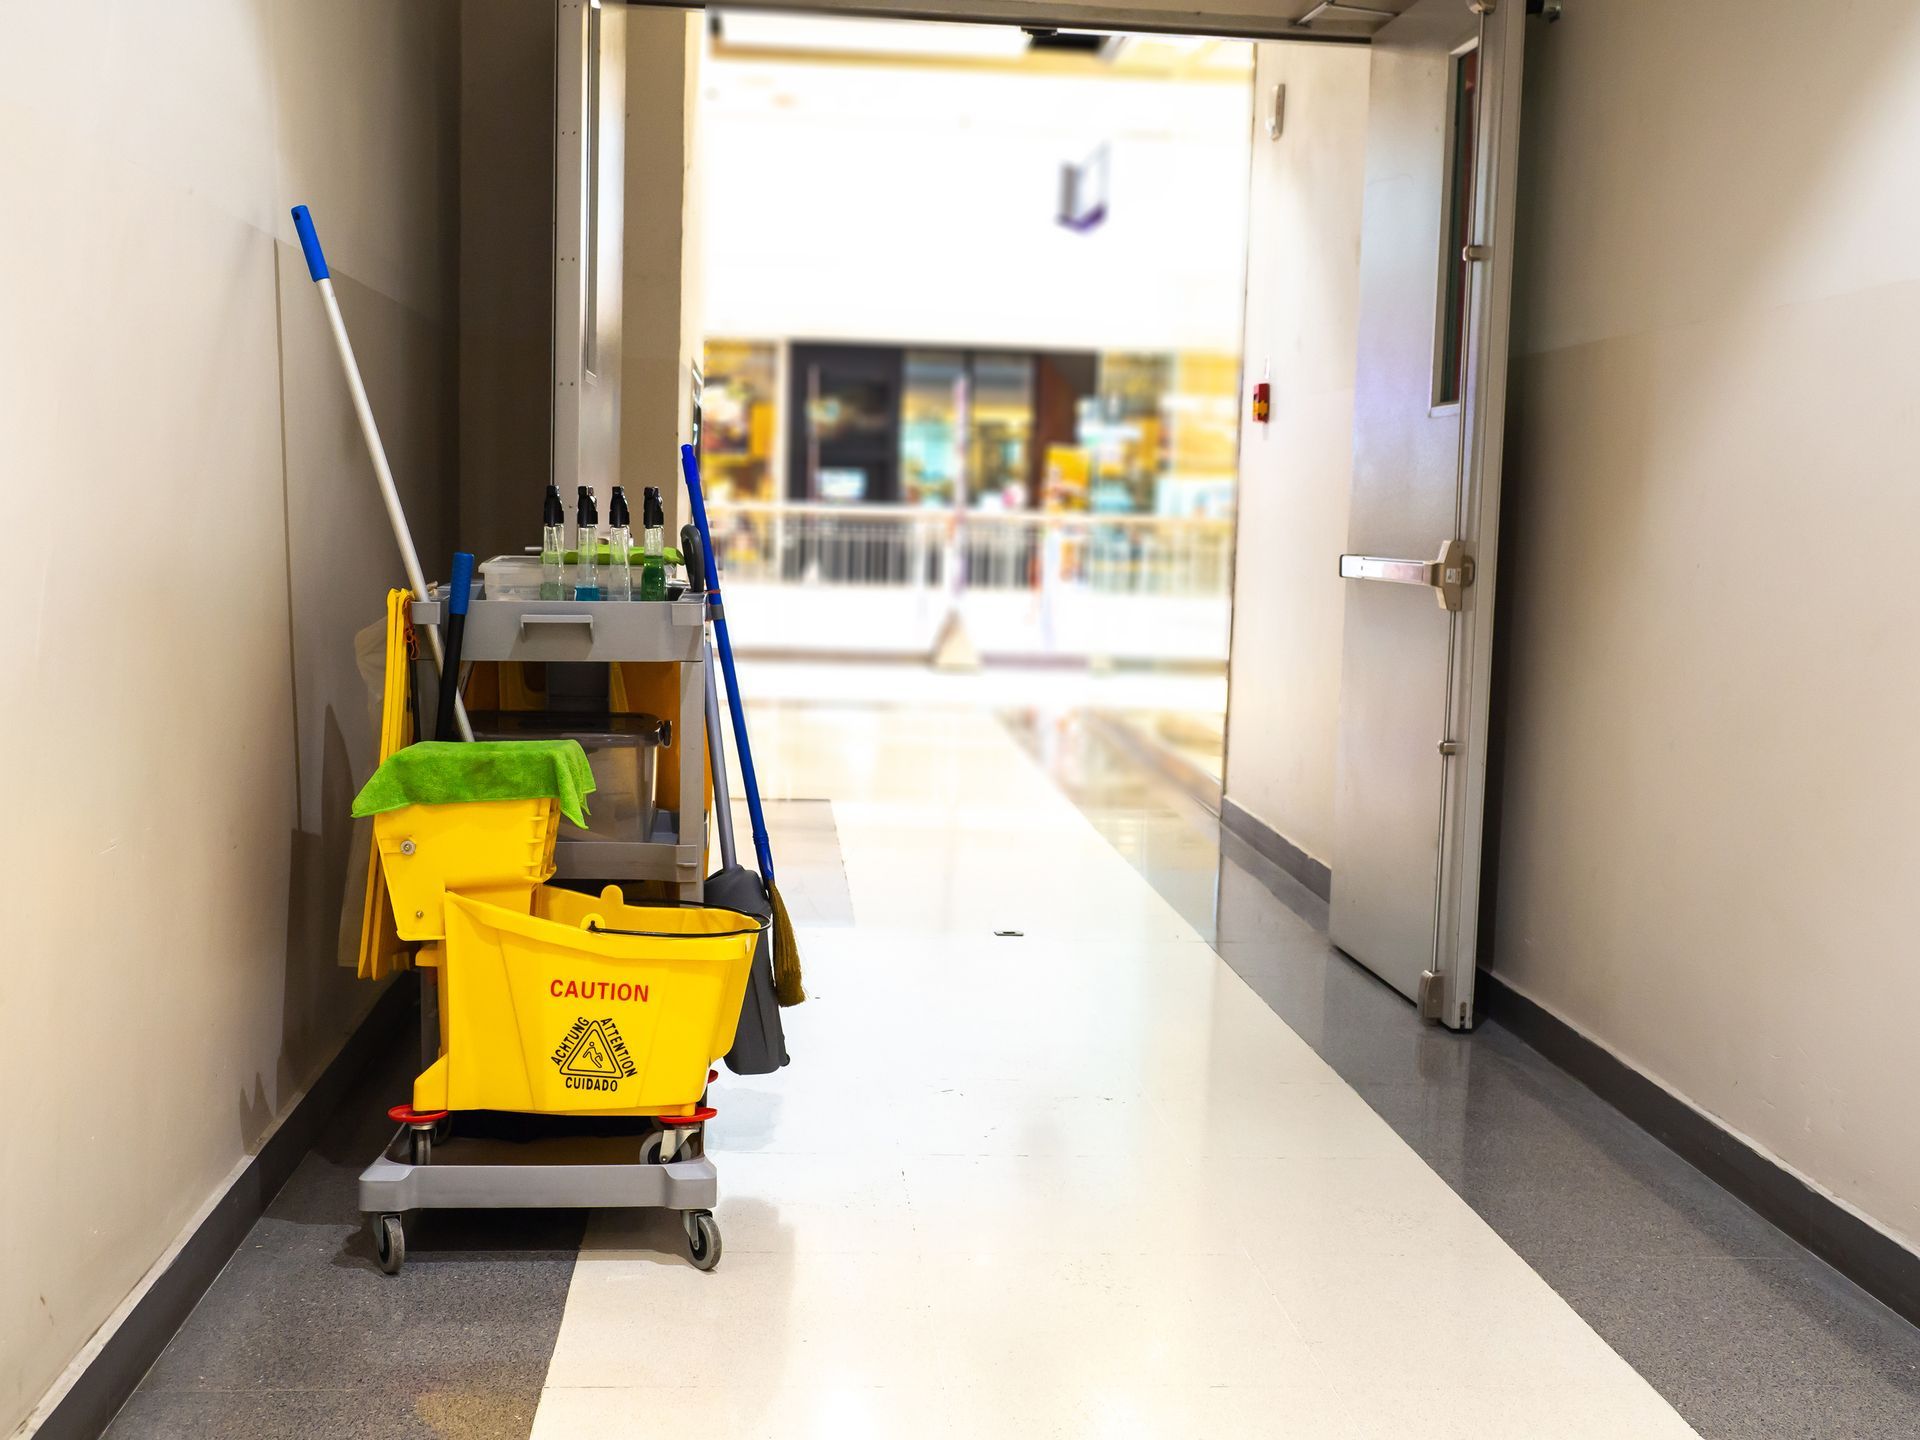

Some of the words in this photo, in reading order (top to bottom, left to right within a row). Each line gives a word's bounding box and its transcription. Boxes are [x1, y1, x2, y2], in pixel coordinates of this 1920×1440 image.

[550, 979, 649, 1002] CAUTION
[550, 1016, 590, 1066] ACHTUNG
[600, 1017, 638, 1078] ATTENTION
[565, 1076, 618, 1092] CUIDADO
